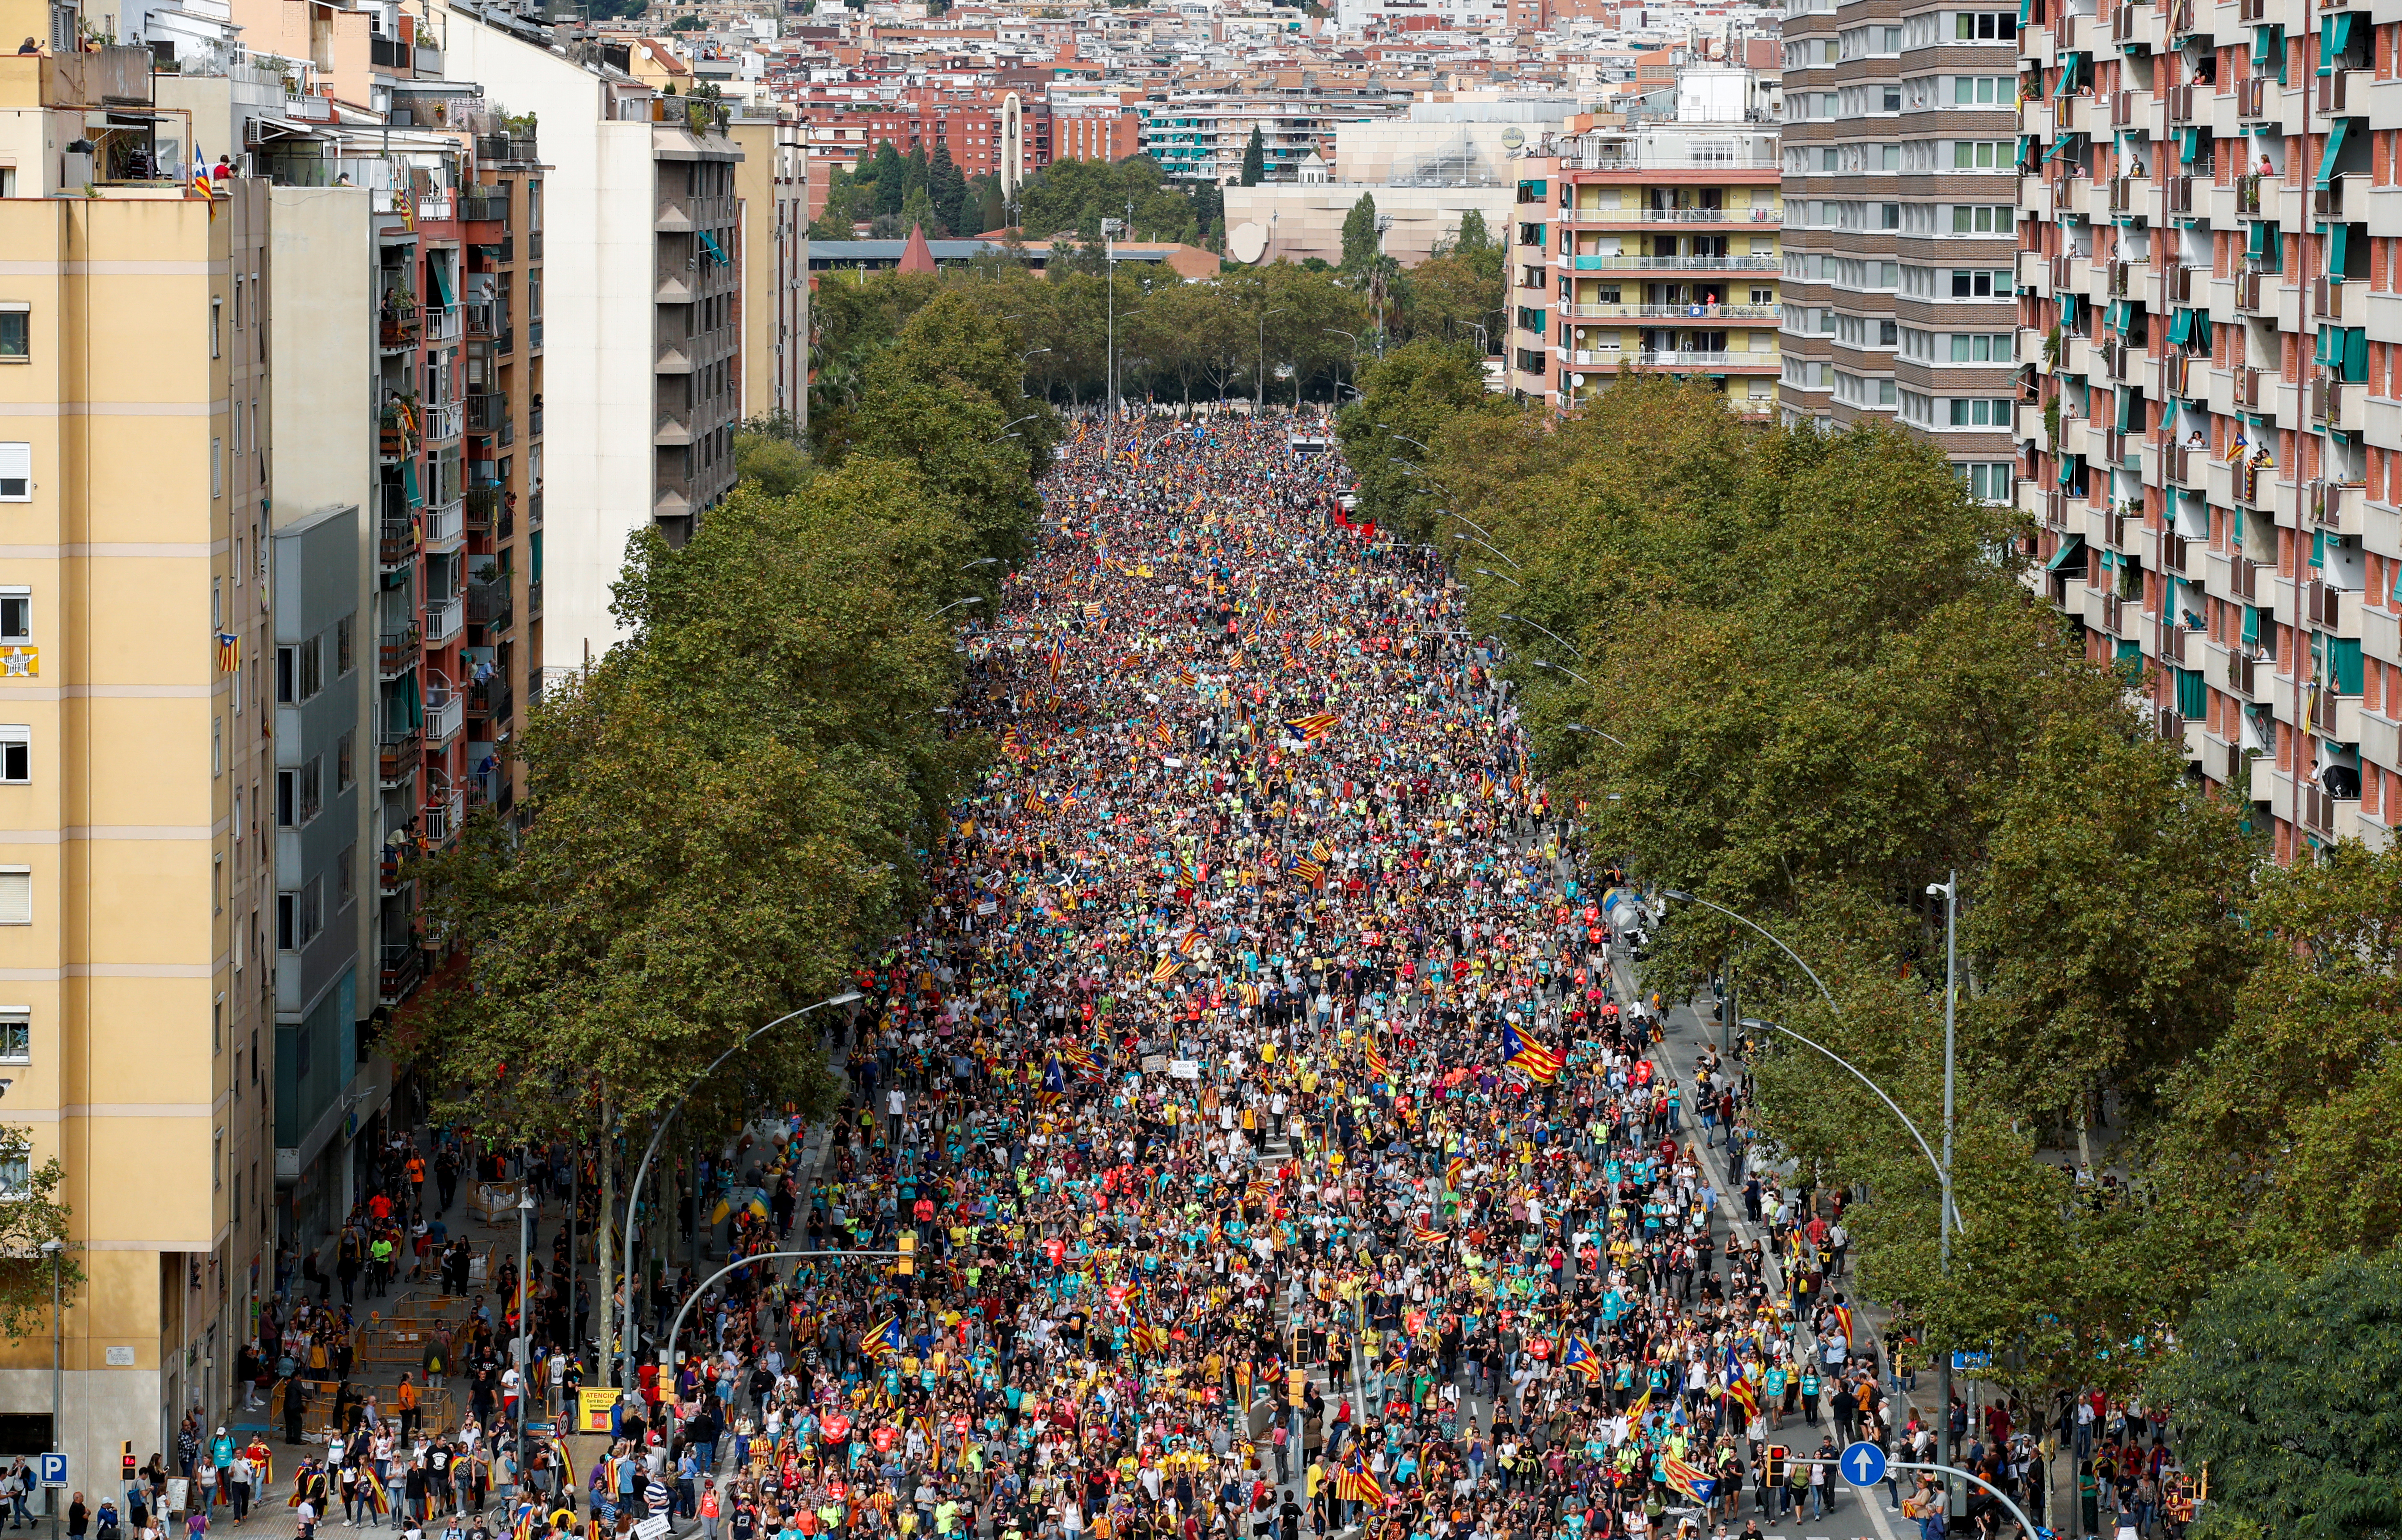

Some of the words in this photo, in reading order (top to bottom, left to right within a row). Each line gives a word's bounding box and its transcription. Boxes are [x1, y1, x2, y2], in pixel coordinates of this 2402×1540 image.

[4, 652, 30, 664] REPÚBLICA
[4, 662, 30, 674] LLIBERTAT
[560, 1420, 567, 1430] 30
[46, 1457, 62, 1479] P
[639, 1524, 669, 1539] independència
[642, 1520, 662, 1532] sentència
